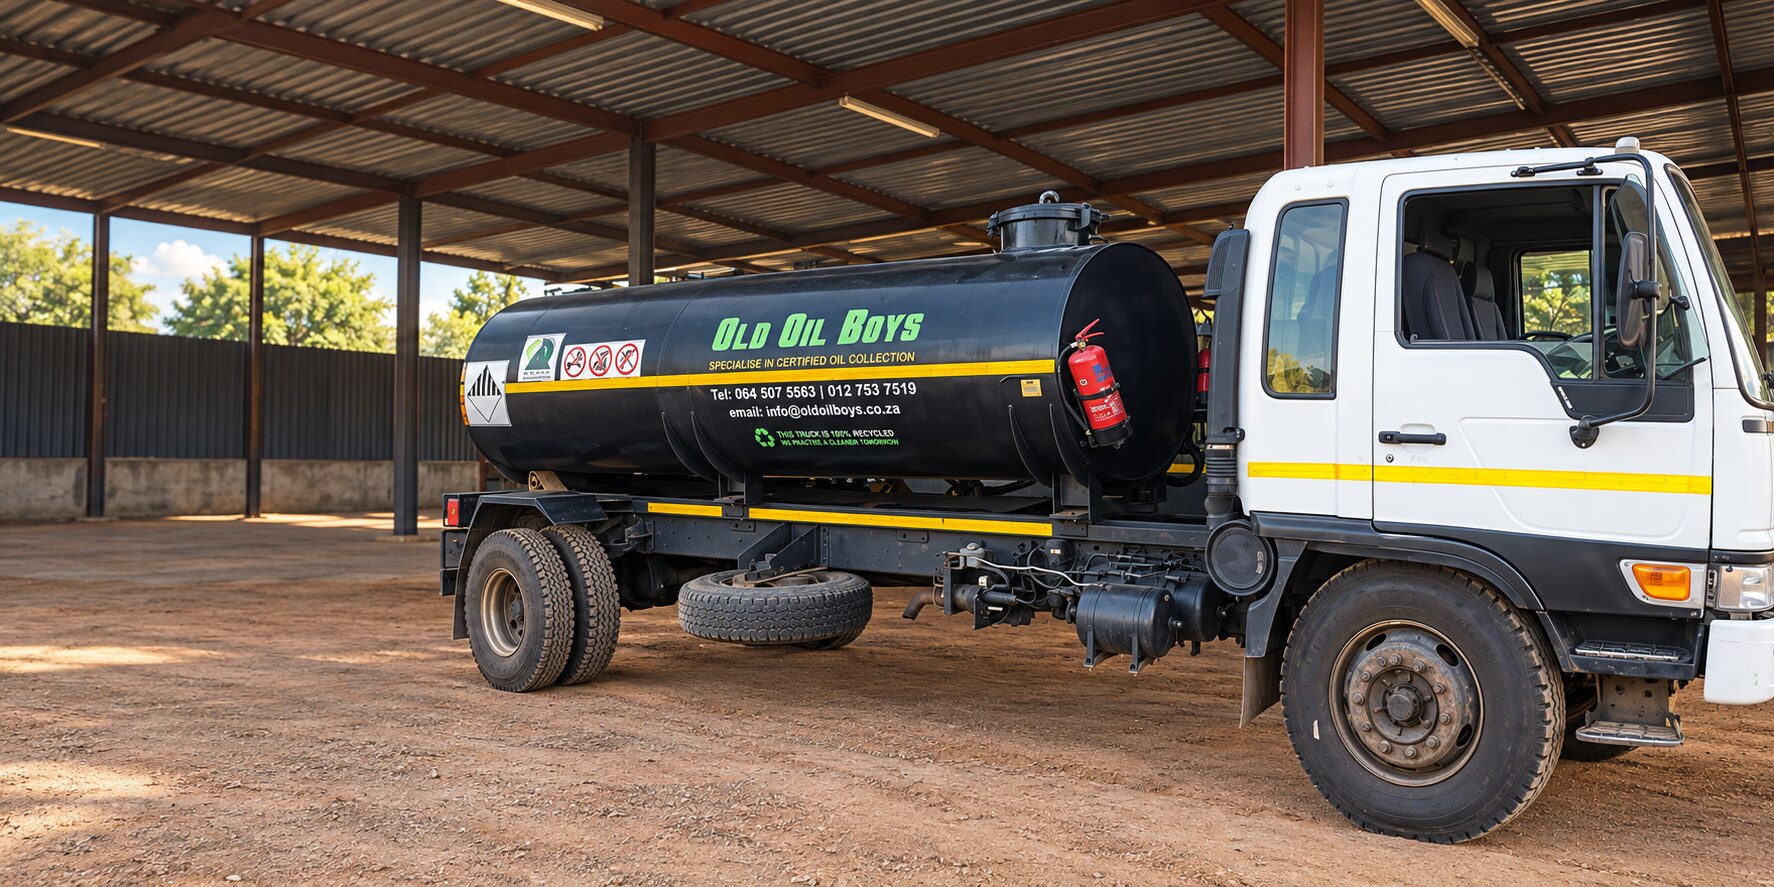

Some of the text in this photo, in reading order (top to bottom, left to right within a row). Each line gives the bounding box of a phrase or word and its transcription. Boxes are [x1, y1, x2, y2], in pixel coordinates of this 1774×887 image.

[708, 351, 915, 371] SPECIALISE IN CERTIFIED OIL COLLECTION
[710, 388, 732, 401] Tel:
[735, 387, 757, 399] 064
[761, 386, 783, 399] 507
[786, 385, 816, 398] 5563
[828, 384, 852, 397] 012
[855, 384, 880, 396] 753
[883, 382, 917, 395] 7519
[729, 404, 901, 419] email: info@oldoilboys.co.za
[852, 429, 894, 437] RECYCLED
